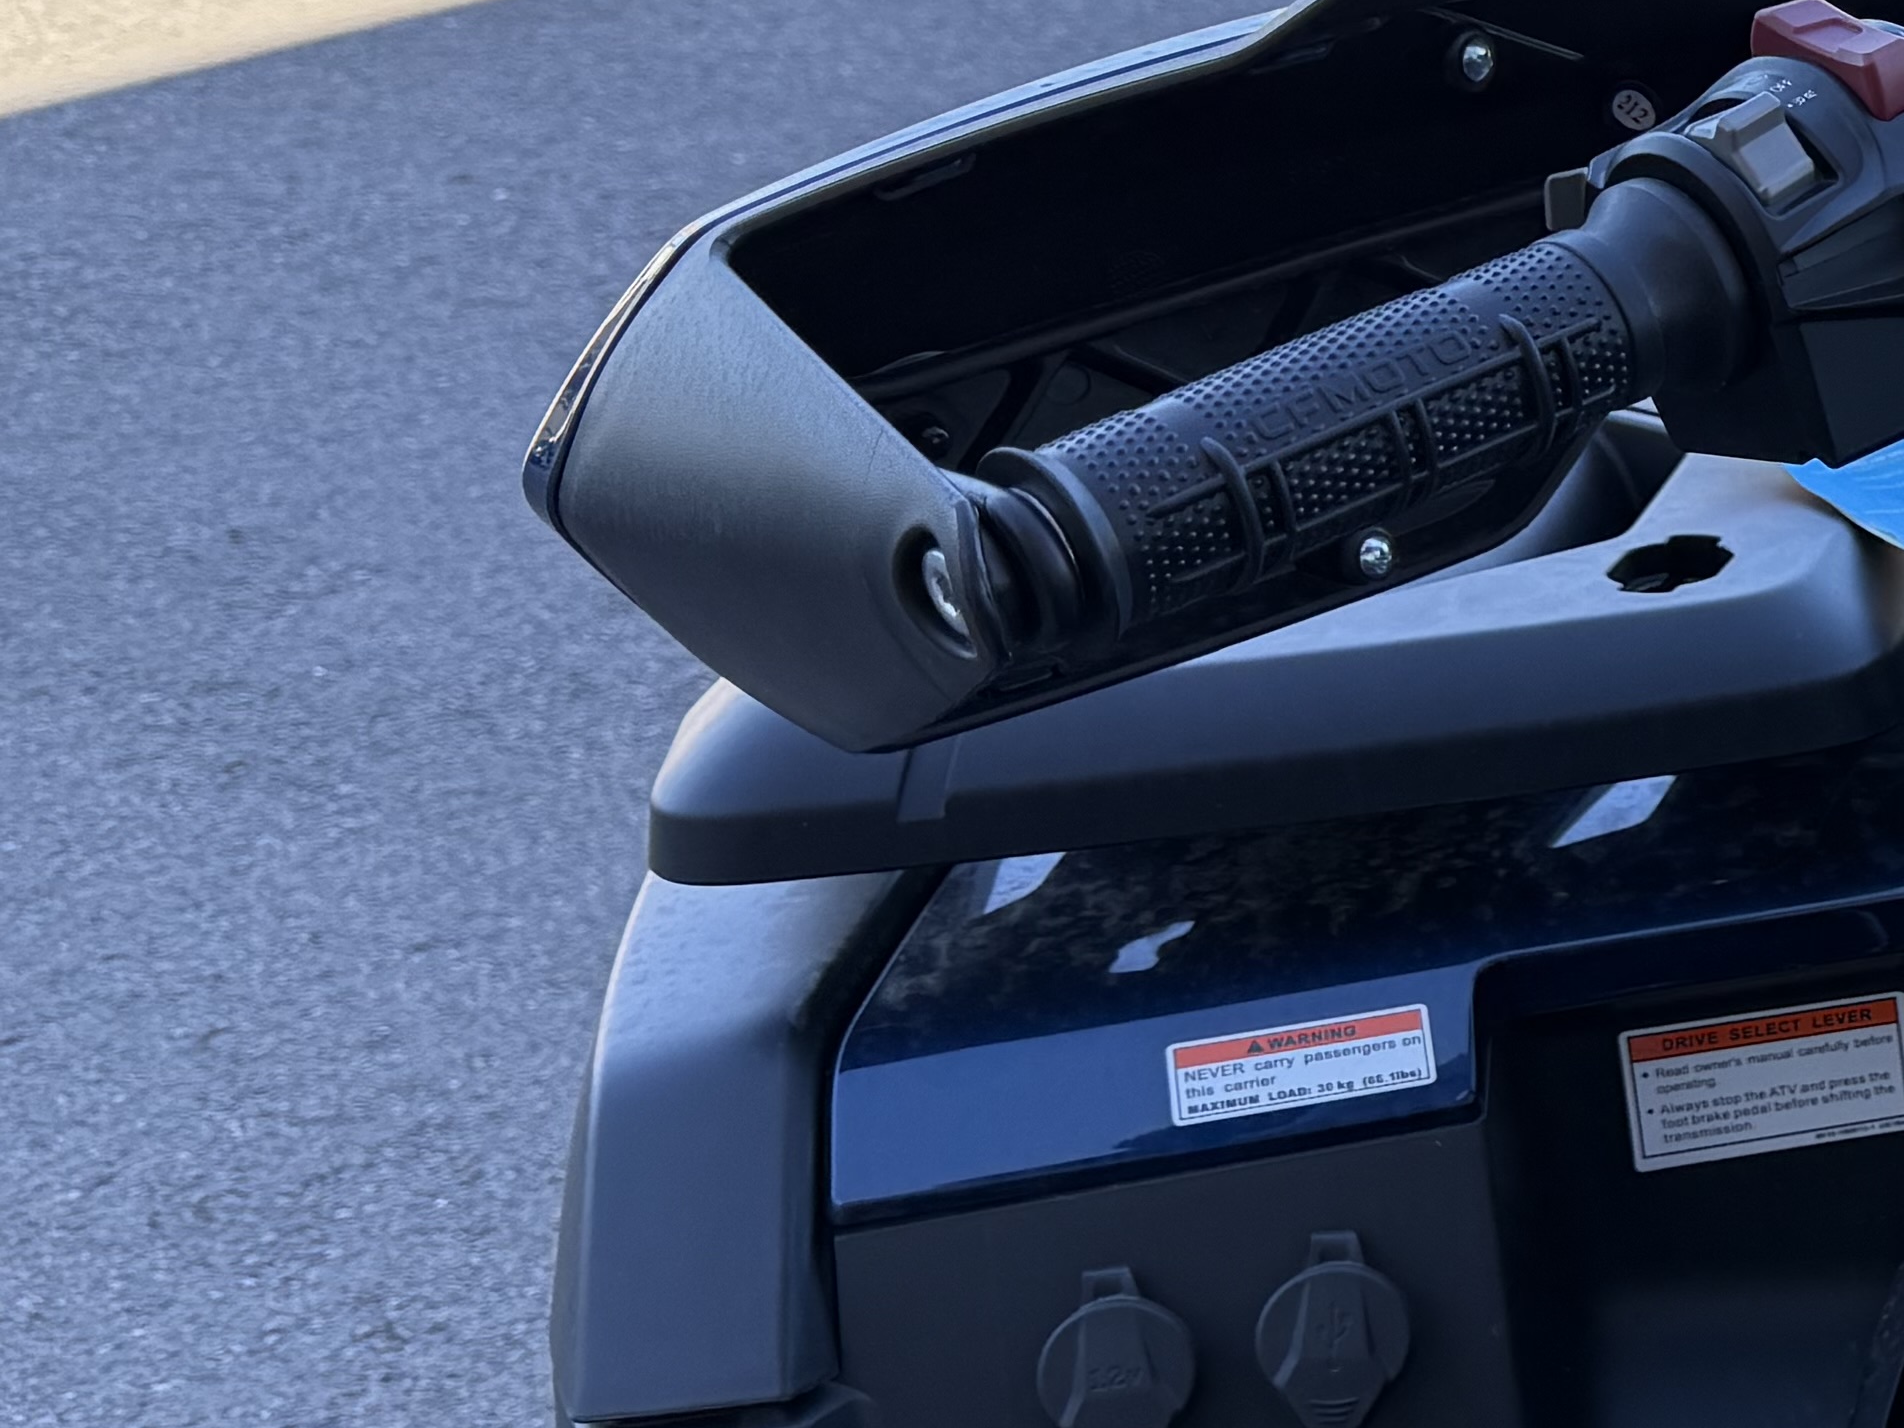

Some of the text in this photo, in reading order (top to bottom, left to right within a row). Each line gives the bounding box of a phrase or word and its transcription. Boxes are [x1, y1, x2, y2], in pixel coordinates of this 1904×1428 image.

[1616, 93, 1650, 125] 212
[1266, 1024, 1357, 1051] WARNING
[1660, 1007, 1873, 1052] DRIVE SELECT LEVER
[1182, 1034, 1422, 1083] NEVER carry passengers on
[1184, 1074, 1276, 1100] this carrier
